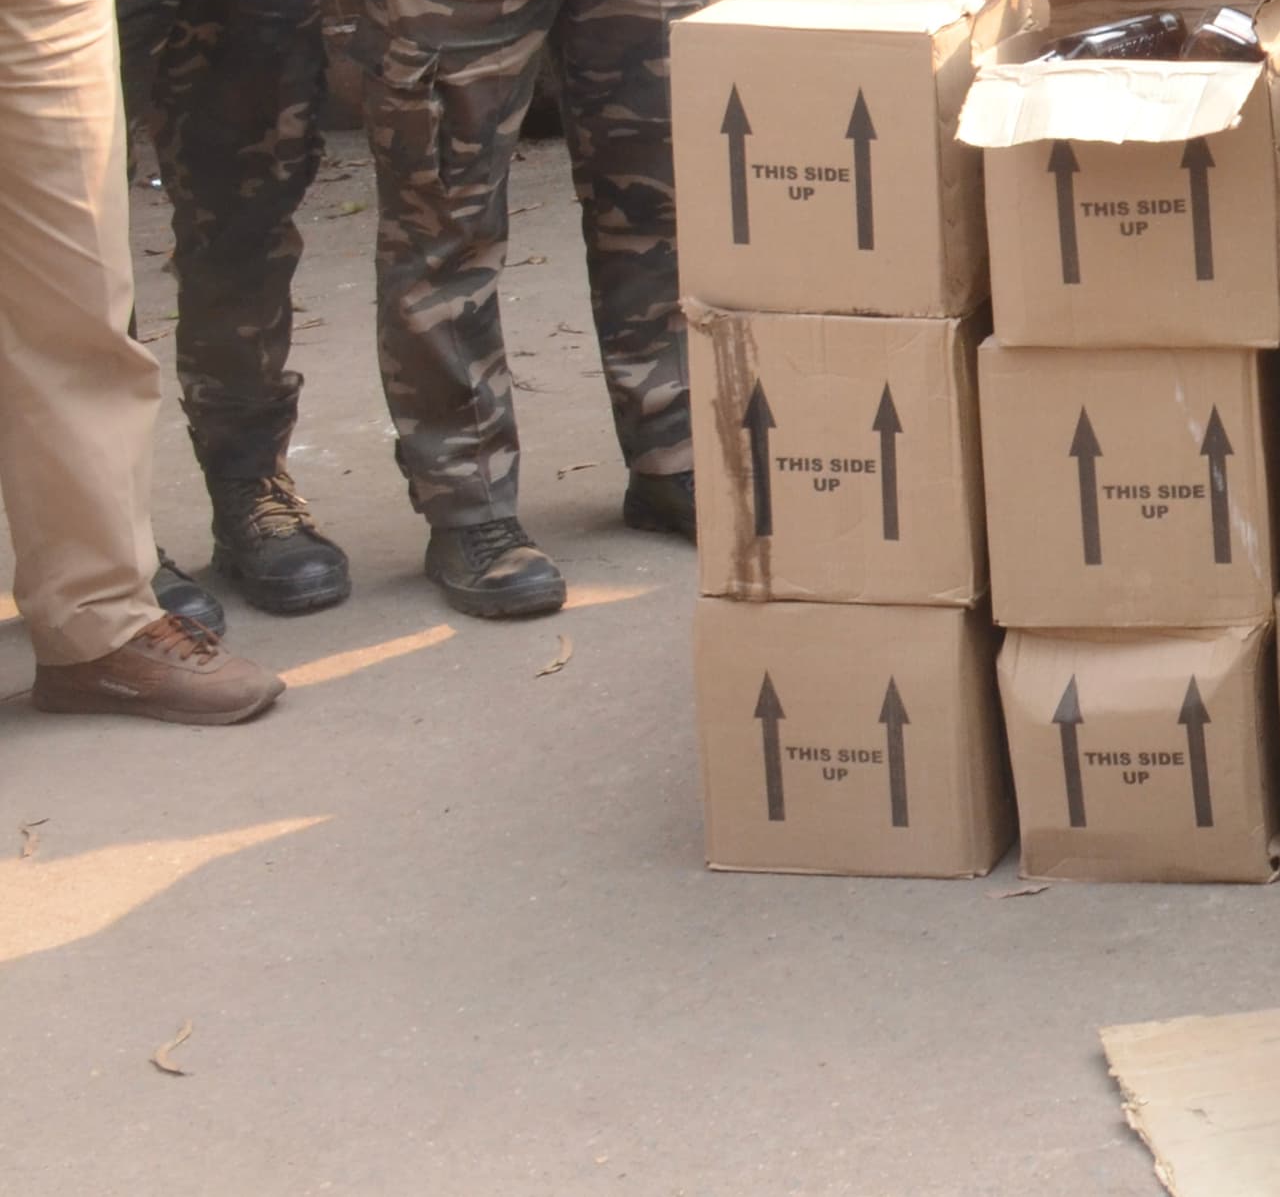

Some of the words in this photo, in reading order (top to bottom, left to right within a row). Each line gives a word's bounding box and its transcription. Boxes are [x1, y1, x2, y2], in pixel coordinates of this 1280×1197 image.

[751, 164, 798, 181] THIS
[804, 166, 850, 183] SIDE
[788, 185, 815, 201] UP
[1080, 201, 1131, 217] THIS
[1136, 198, 1187, 215] SIDE
[1119, 220, 1149, 237] UP
[775, 457, 823, 473] THIS
[829, 458, 876, 474] SIDE
[813, 477, 841, 492] UP
[1102, 485, 1151, 500] THIS
[1157, 484, 1205, 499] SIDE
[1141, 505, 1169, 519] UP
[785, 746, 832, 762] THIS
[837, 749, 883, 764] SIDE
[1083, 751, 1132, 766] THIS
[1138, 751, 1185, 766] SIDE
[822, 767, 849, 782] UP
[1122, 771, 1150, 785] UP
